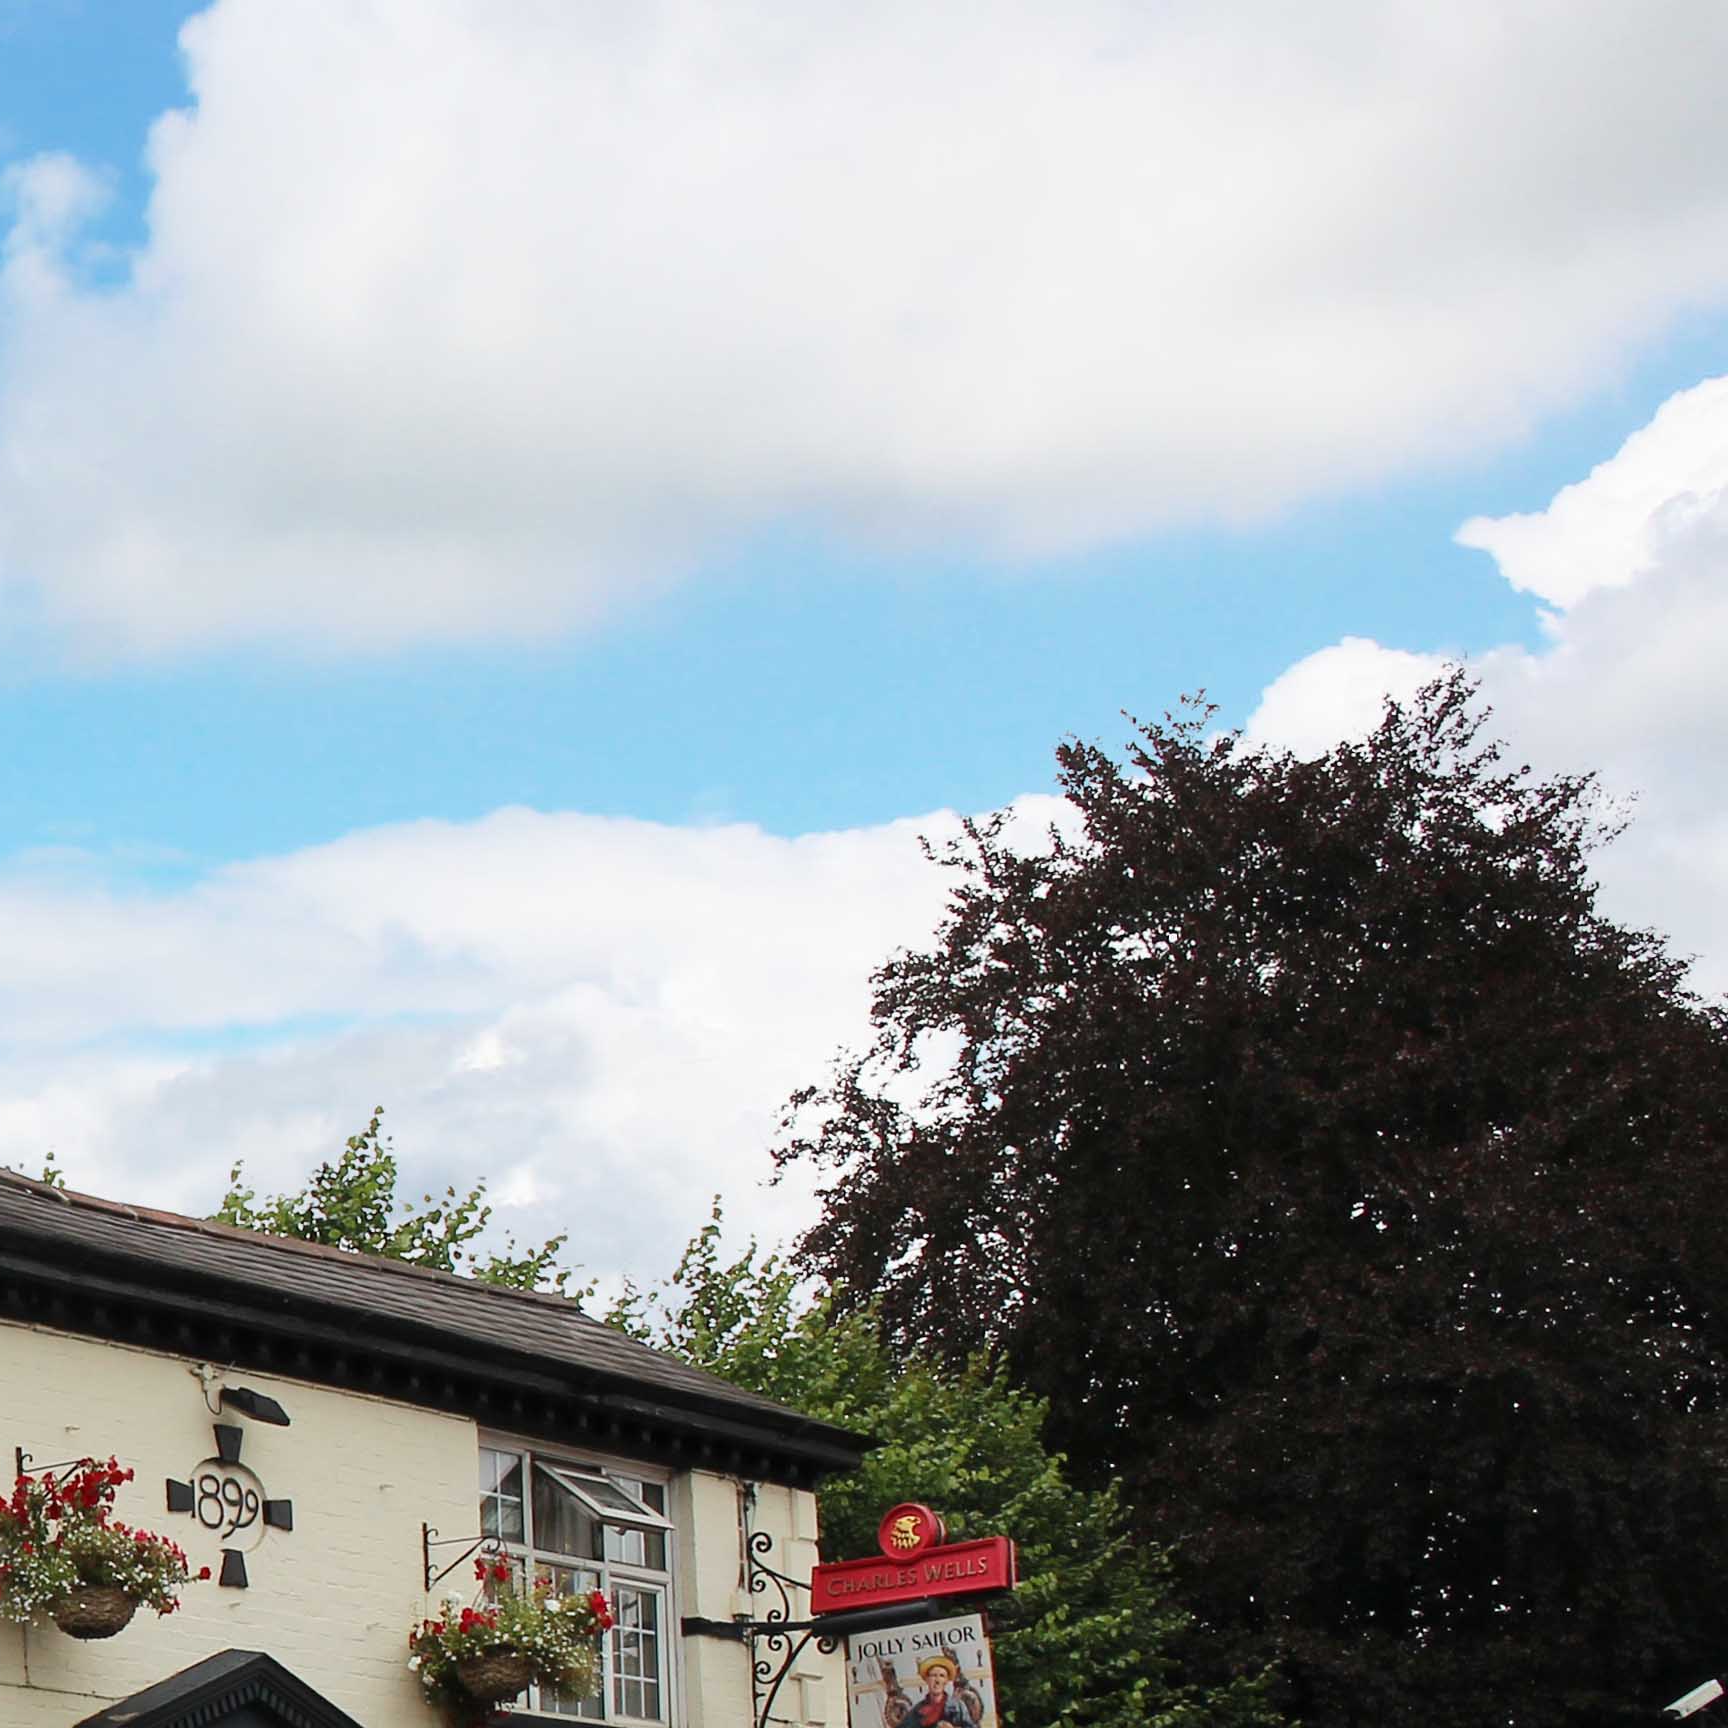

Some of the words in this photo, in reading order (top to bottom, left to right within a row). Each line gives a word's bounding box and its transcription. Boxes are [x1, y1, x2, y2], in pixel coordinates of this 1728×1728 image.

[827, 1568, 917, 1596] CHARLES
[923, 1556, 987, 1584] WELLS
[857, 1636, 906, 1663] JOLLY
[911, 1626, 976, 1652] SAILOR
